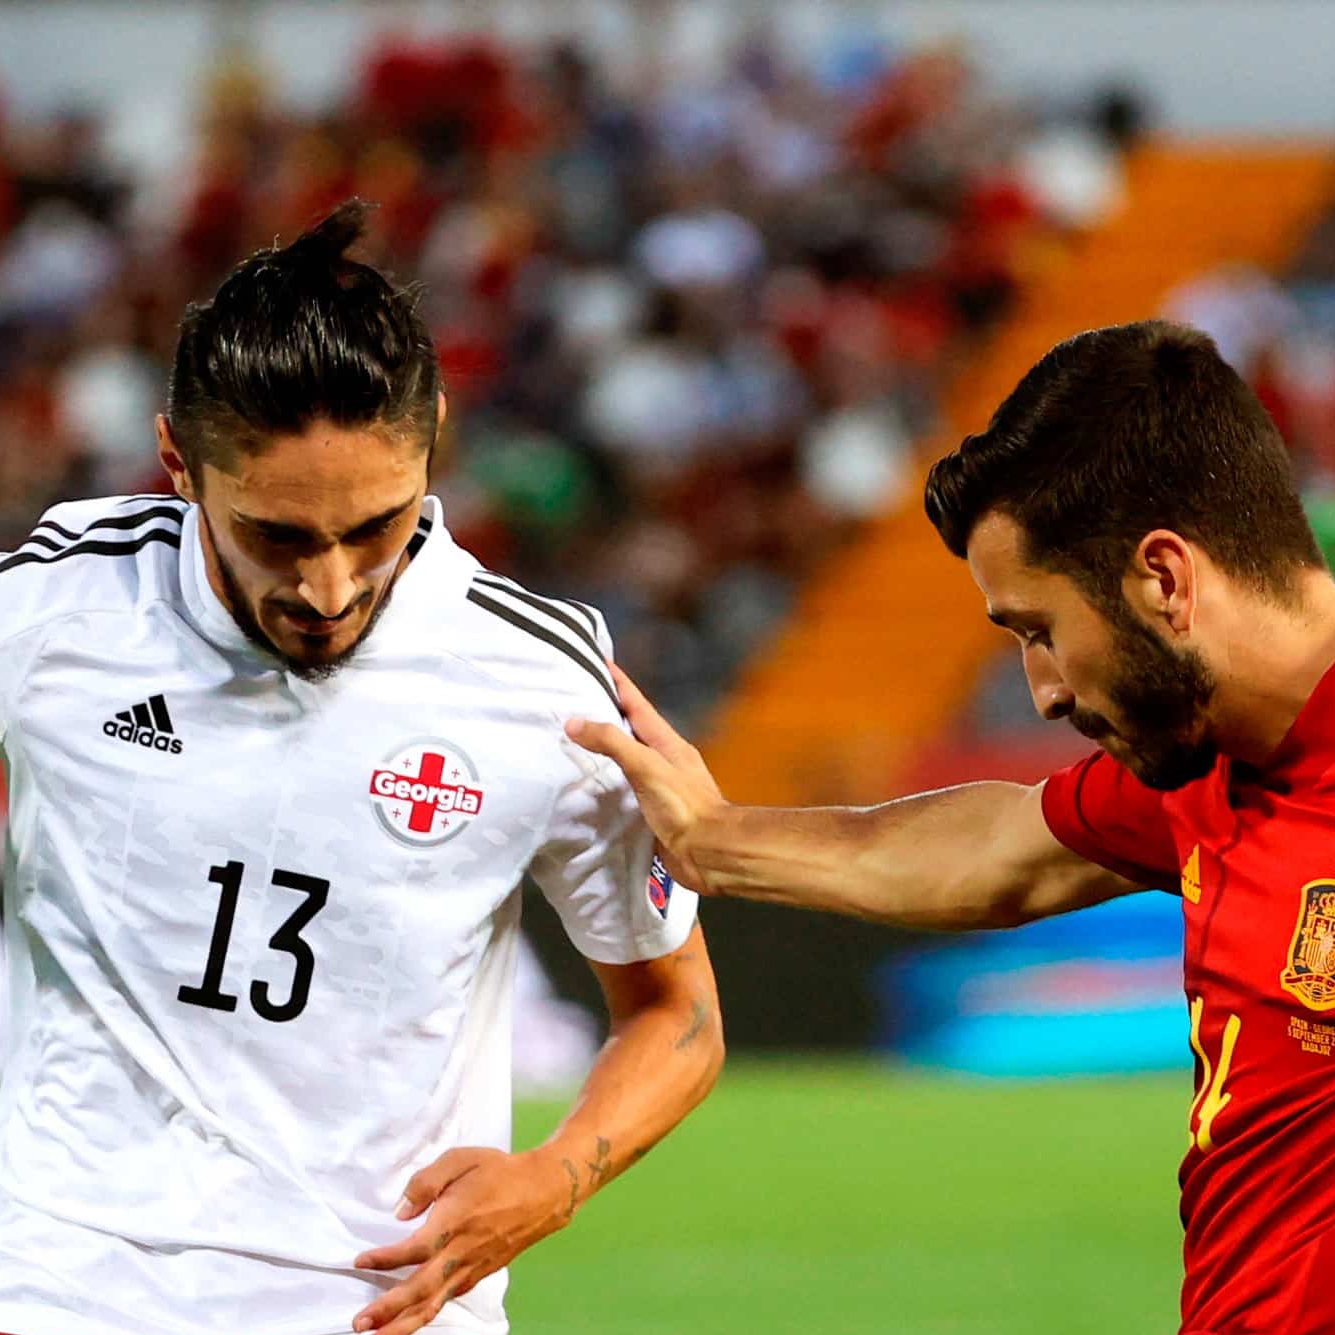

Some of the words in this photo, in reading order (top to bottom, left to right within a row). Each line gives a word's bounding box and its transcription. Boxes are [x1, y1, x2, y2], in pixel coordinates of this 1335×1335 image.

[103, 720, 184, 755] adidas
[374, 771, 480, 813] Georgia
[177, 860, 330, 1022] 13
